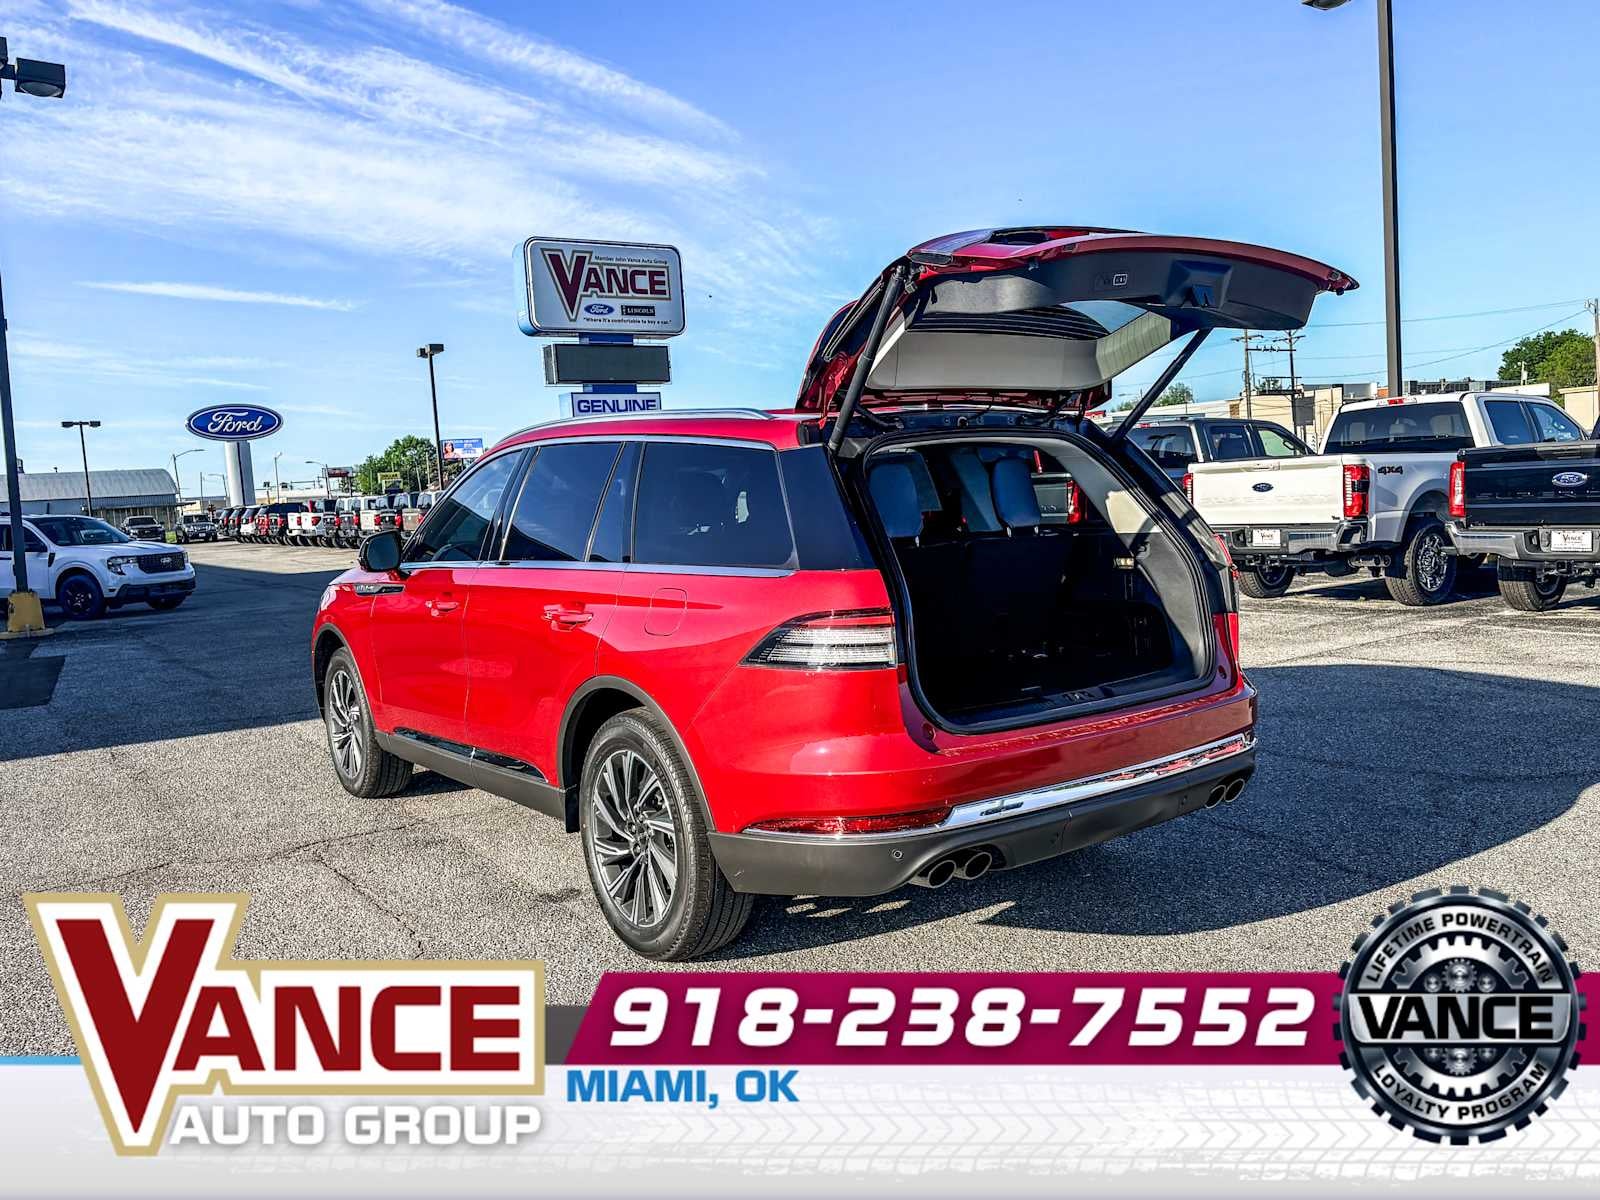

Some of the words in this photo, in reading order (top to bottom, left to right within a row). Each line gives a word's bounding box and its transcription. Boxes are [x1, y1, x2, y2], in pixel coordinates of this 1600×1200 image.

[544, 250, 669, 318] VANCE
[590, 305, 609, 313] Ford
[577, 399, 657, 413] GENUINE
[207, 411, 264, 433] Ford
